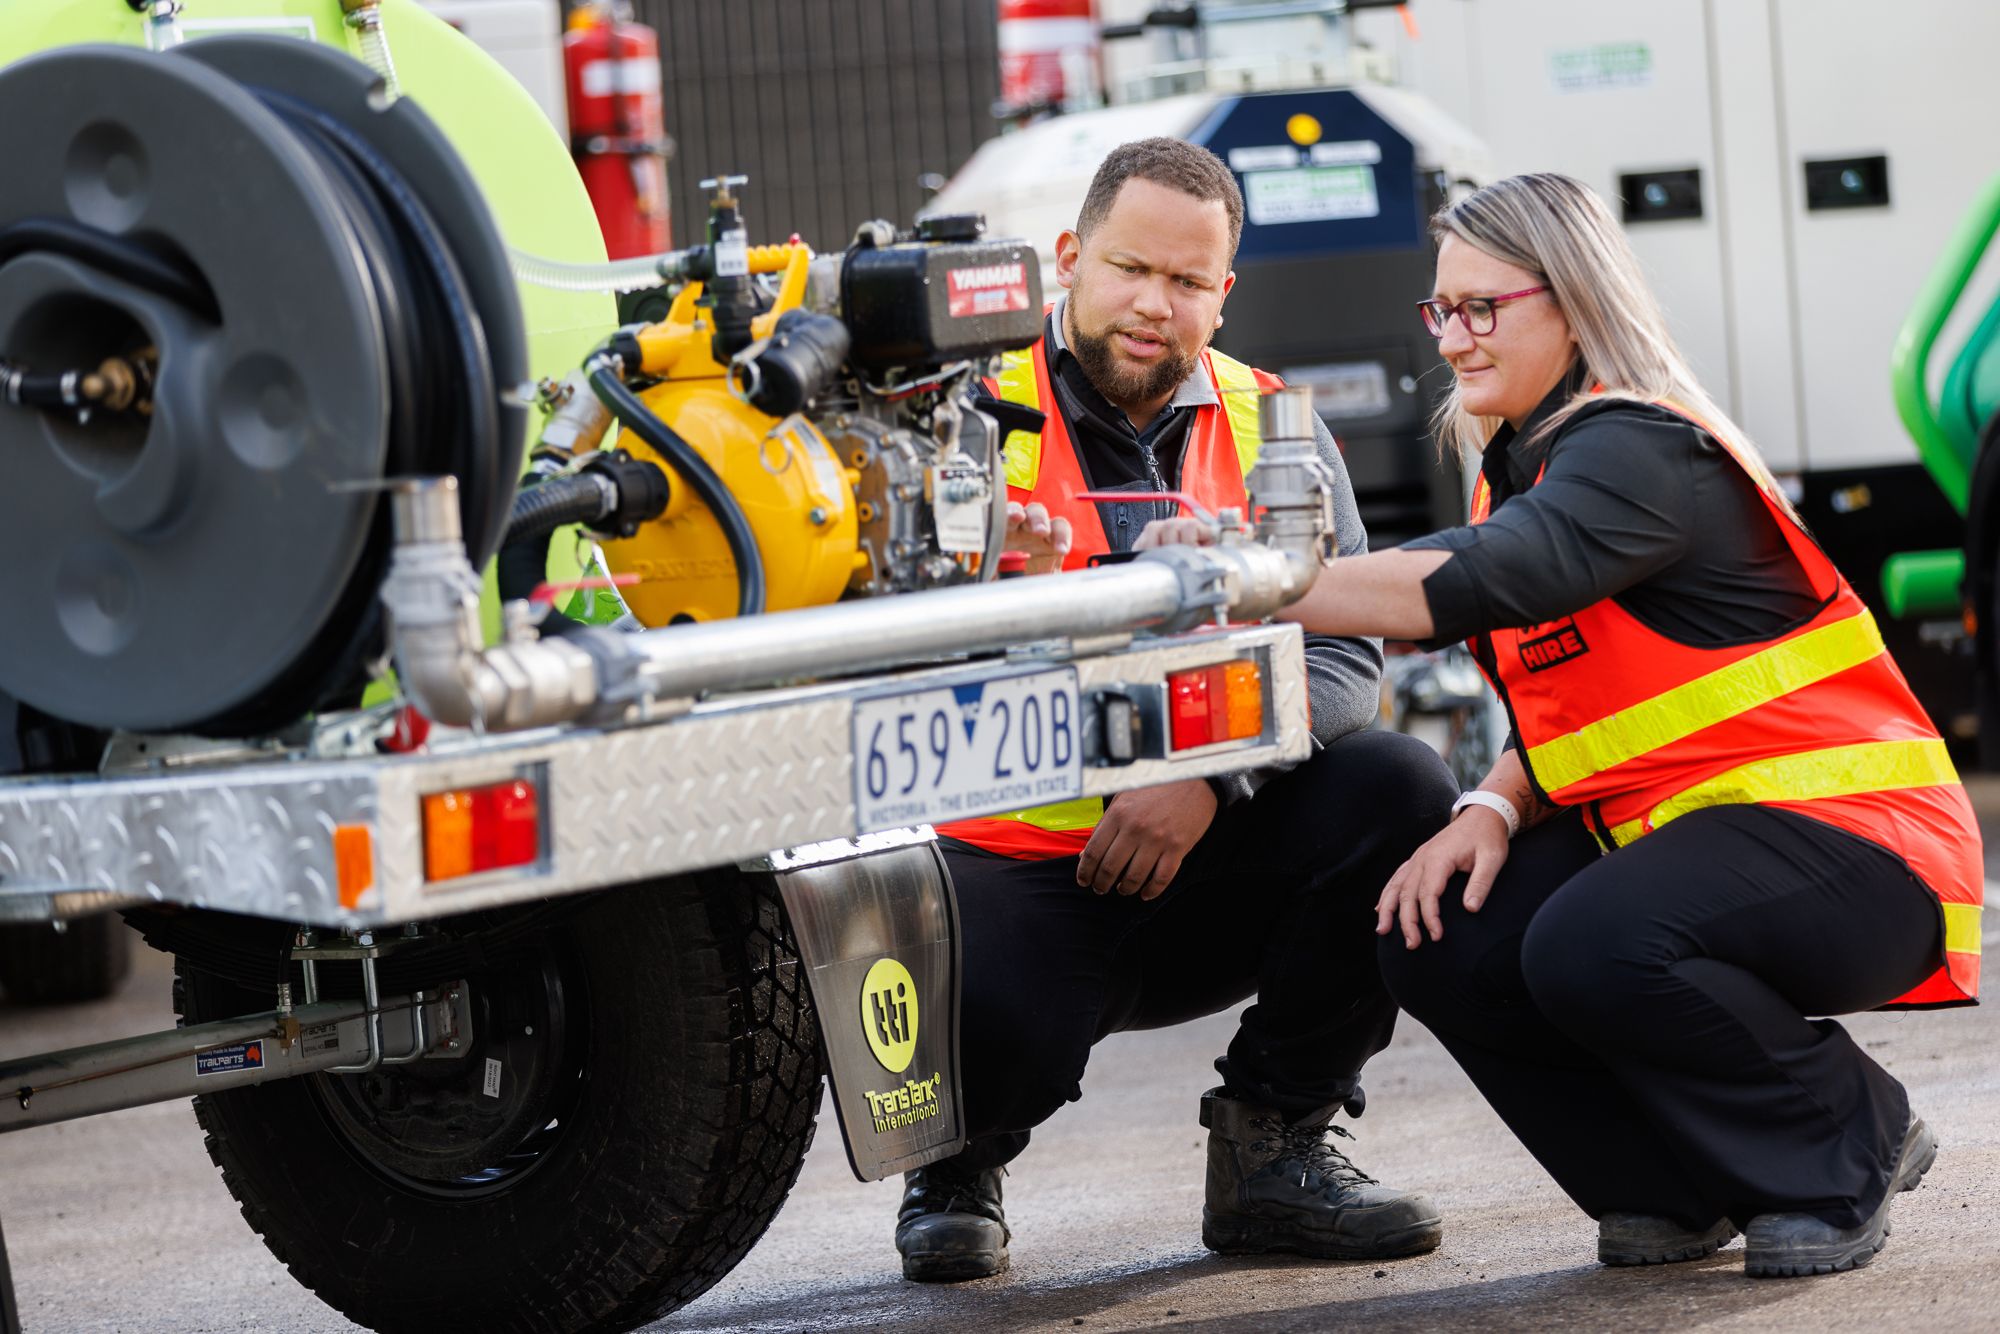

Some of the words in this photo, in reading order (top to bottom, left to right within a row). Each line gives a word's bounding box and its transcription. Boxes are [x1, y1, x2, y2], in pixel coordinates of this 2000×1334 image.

[952, 263, 1022, 291] YANMAR
[1521, 629, 1583, 669] HIRE
[867, 709, 950, 799] 659
[991, 690, 1072, 779] 20B
[868, 802, 928, 825] VICTORIA
[939, 794, 962, 812] THE
[966, 783, 1032, 808] EDUCATION
[1036, 775, 1069, 796] STATE
[869, 981, 910, 1047] tti
[874, 1100, 940, 1134] International
